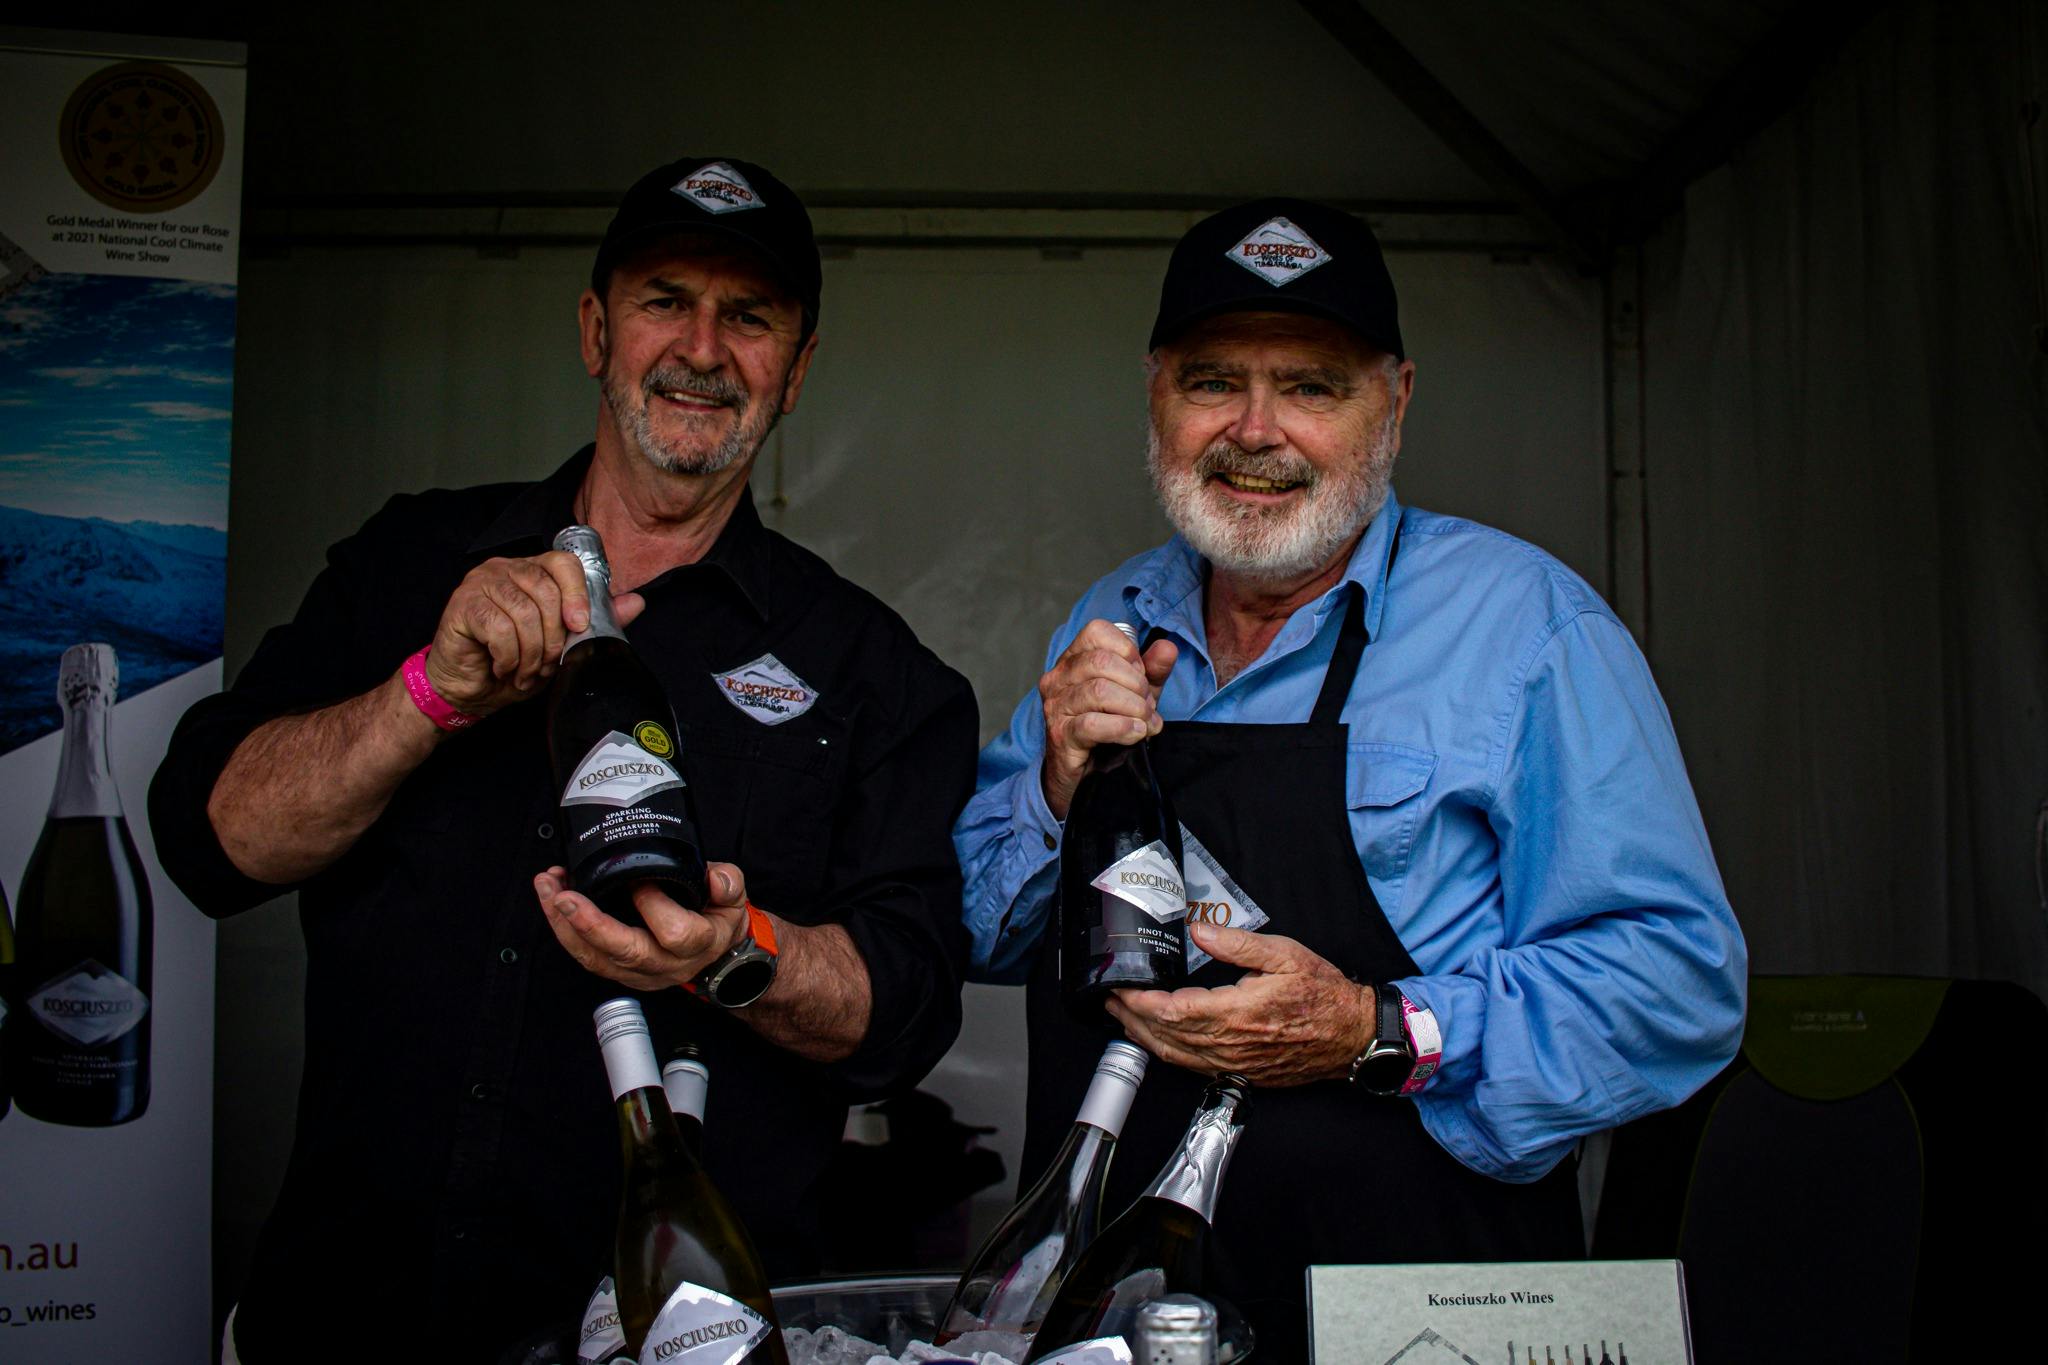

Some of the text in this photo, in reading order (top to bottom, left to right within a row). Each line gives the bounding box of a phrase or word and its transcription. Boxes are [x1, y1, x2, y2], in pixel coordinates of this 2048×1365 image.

[47, 215, 229, 238] Gold Medal Winner for our Rose
[52, 232, 223, 252] at 2021 National Cool Climate
[106, 249, 170, 264] Wine Show
[1243, 243, 1317, 259] KOSCIUSZKO
[726, 678, 807, 702] KOSCIUSZKO
[644, 735, 667, 747] GOLD
[579, 762, 665, 790] KOSCIUSZKO
[605, 807, 652, 820] SPARKLING
[579, 811, 683, 842] PINOT NOIR CHARDONNAY
[604, 822, 660, 836] TUMBARUMBA
[604, 826, 660, 843] VINTAGE 2021
[1120, 871, 1186, 900] KOSCIUSZKO
[1137, 927, 1180, 945] PINOT NOIR
[1139, 938, 1181, 954] TUMBARUMBA
[1155, 947, 1169, 955] 2021
[43, 998, 133, 1015] KOSCIUSZKO
[1428, 1291, 1554, 1307] Kosciuszko Wines
[653, 1318, 748, 1361] KOSCIUSZKO
